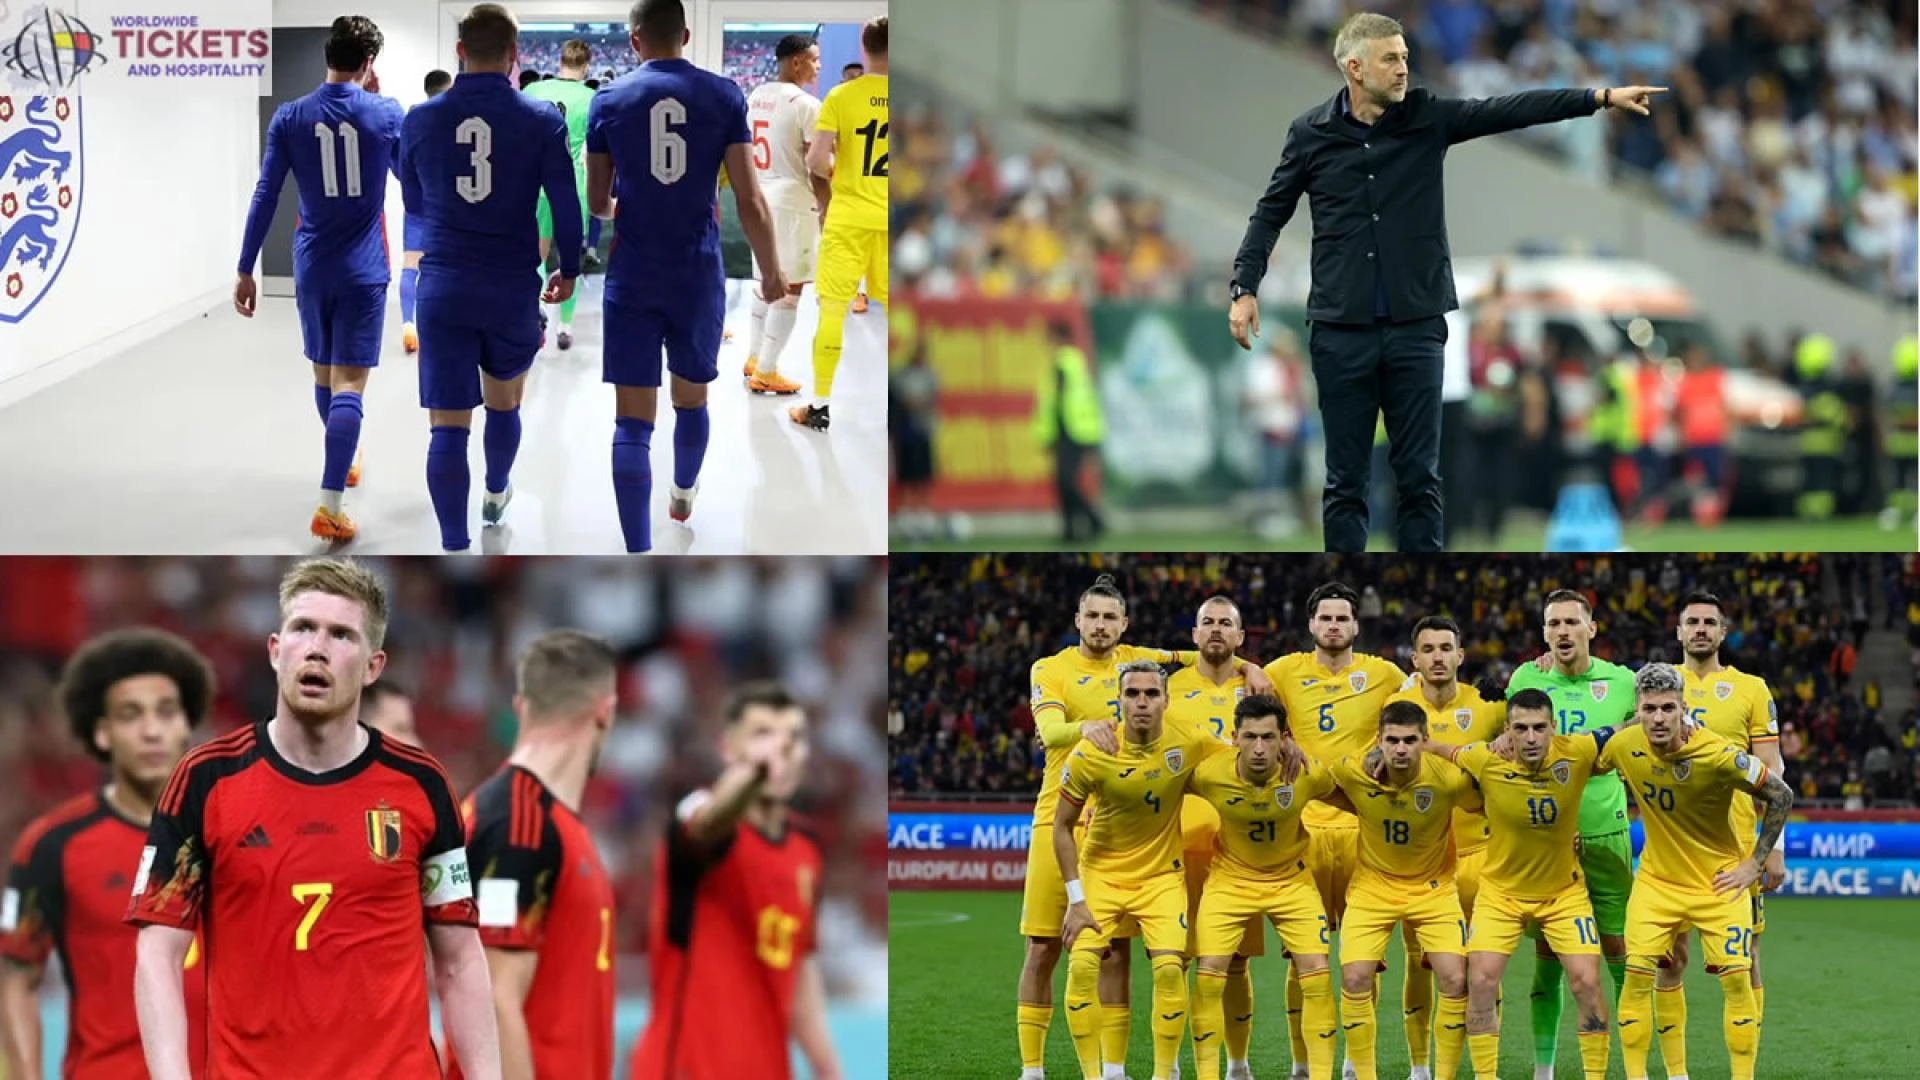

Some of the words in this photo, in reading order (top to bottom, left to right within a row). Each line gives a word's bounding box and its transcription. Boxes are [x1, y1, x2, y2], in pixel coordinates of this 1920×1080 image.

[650, 97, 687, 185] 6
[752, 120, 771, 170] 5
[315, 122, 361, 198] 11
[455, 116, 492, 203] 3
[1318, 703, 1336, 732] 6
[1558, 709, 1586, 736] 12
[1144, 790, 1160, 813] 4
[1643, 781, 1675, 811] 20
[1527, 797, 1558, 825] 10
[888, 823, 945, 849] ACE
[1249, 820, 1275, 842] 21
[1382, 819, 1409, 845] 18
[292, 883, 333, 951] 7
[1574, 917, 1598, 944] 10
[1724, 926, 1752, 957] 20
